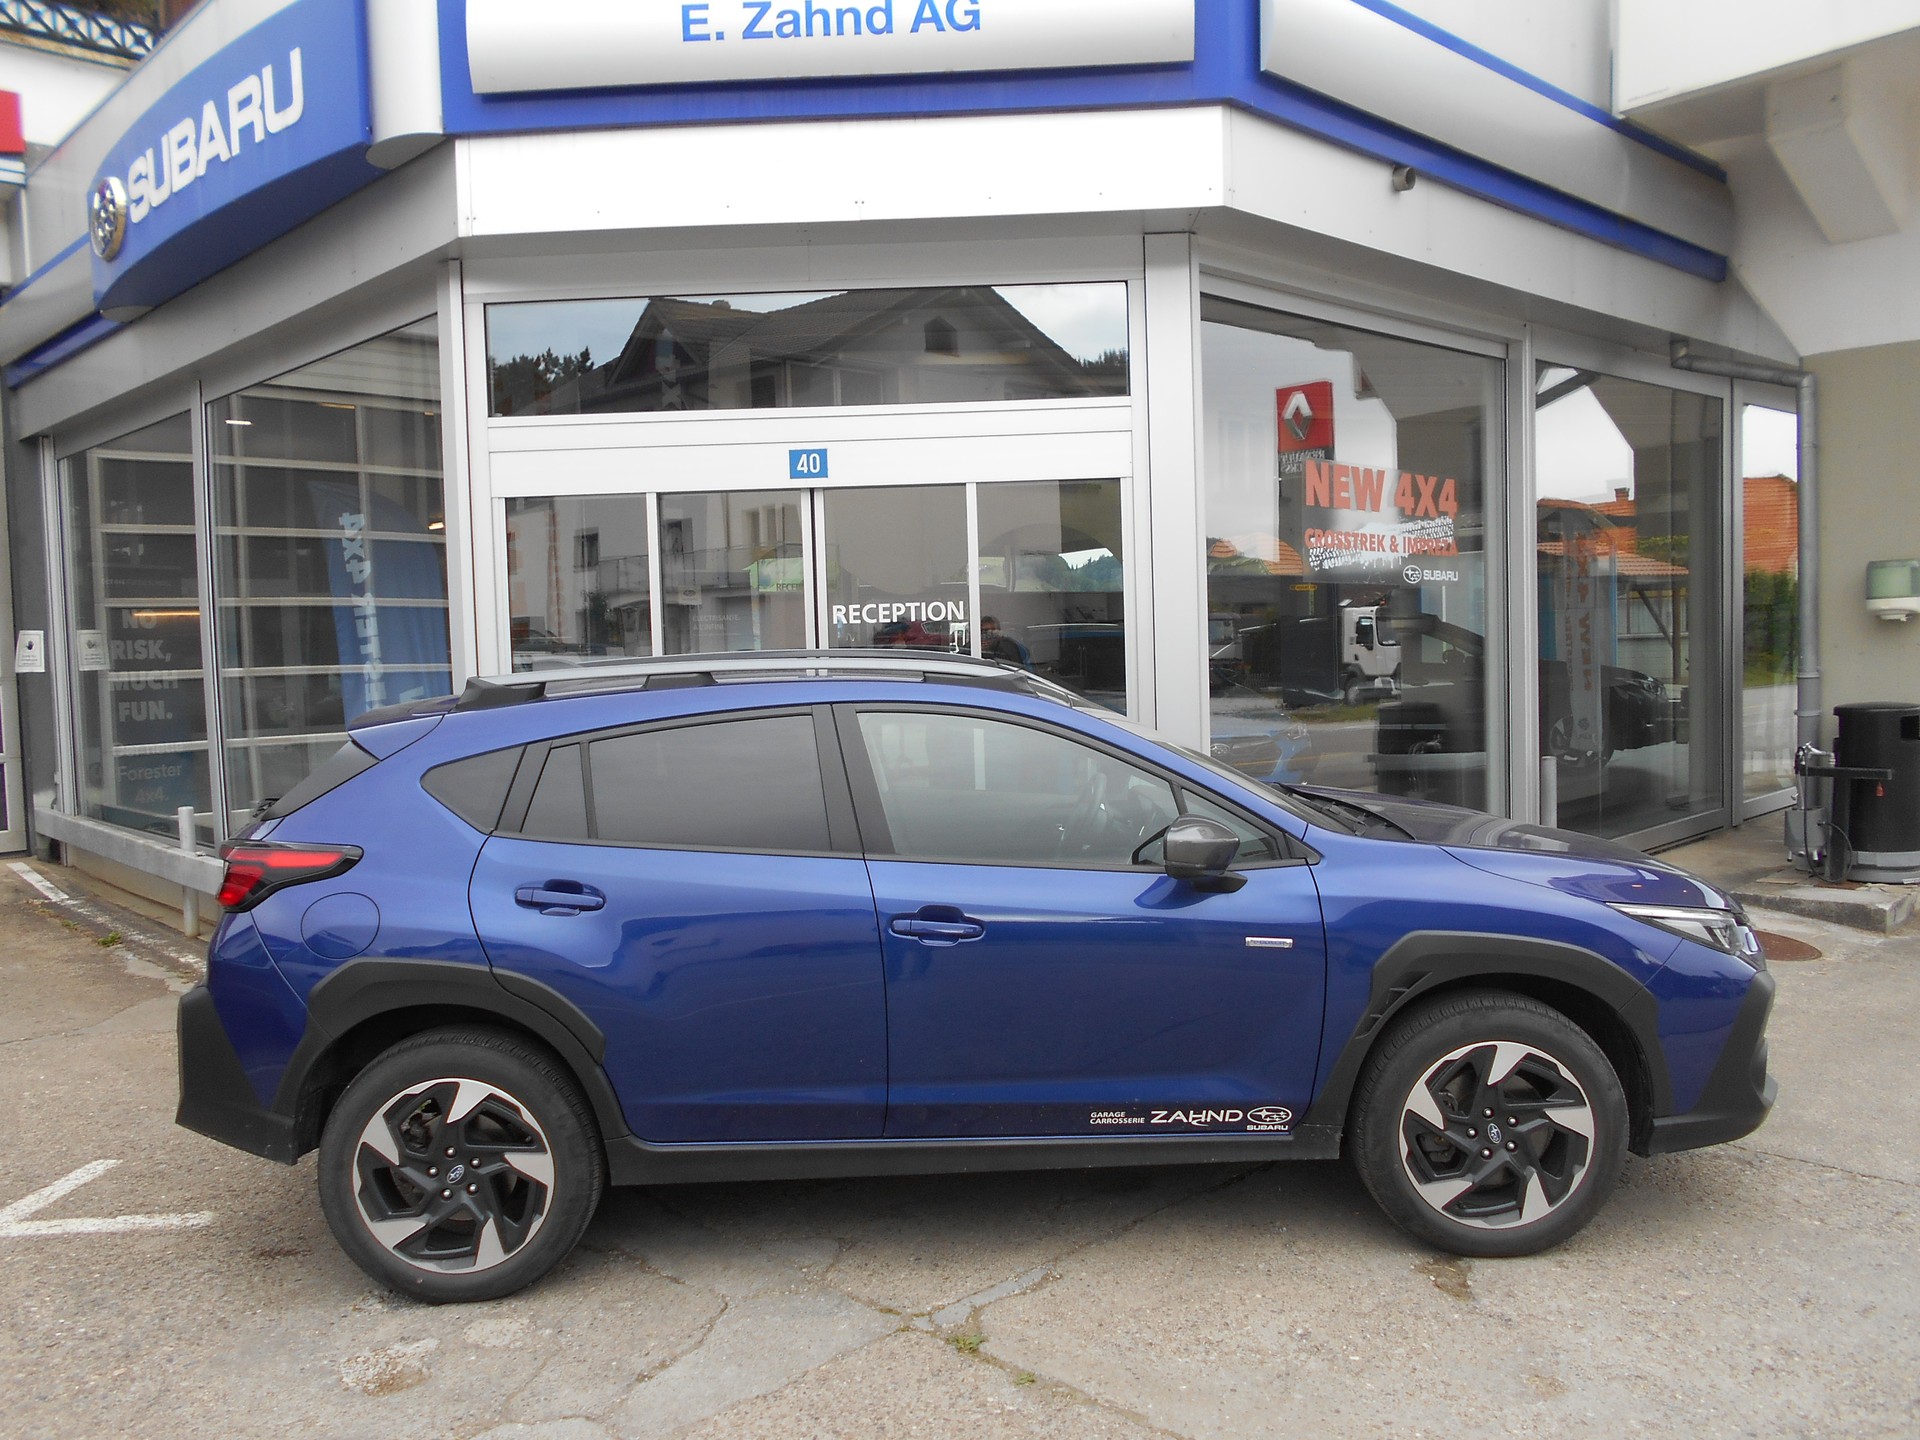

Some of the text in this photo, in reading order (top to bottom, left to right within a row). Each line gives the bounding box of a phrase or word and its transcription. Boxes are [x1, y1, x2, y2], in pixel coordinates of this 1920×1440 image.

[681, 0, 981, 42] E. Zahnd AG
[127, 46, 304, 224] SUBARU
[796, 453, 820, 474] 40
[1305, 459, 1458, 519] NEW 4X4
[1304, 527, 1459, 557] CROSSTREK & IMPREZA
[1423, 570, 1459, 582] SUBARU
[121, 609, 157, 629] NO
[832, 600, 964, 625] RECEPTION
[109, 640, 171, 662] RISK,
[119, 700, 173, 721] FUN.
[1151, 1109, 1243, 1126] ZAHND
